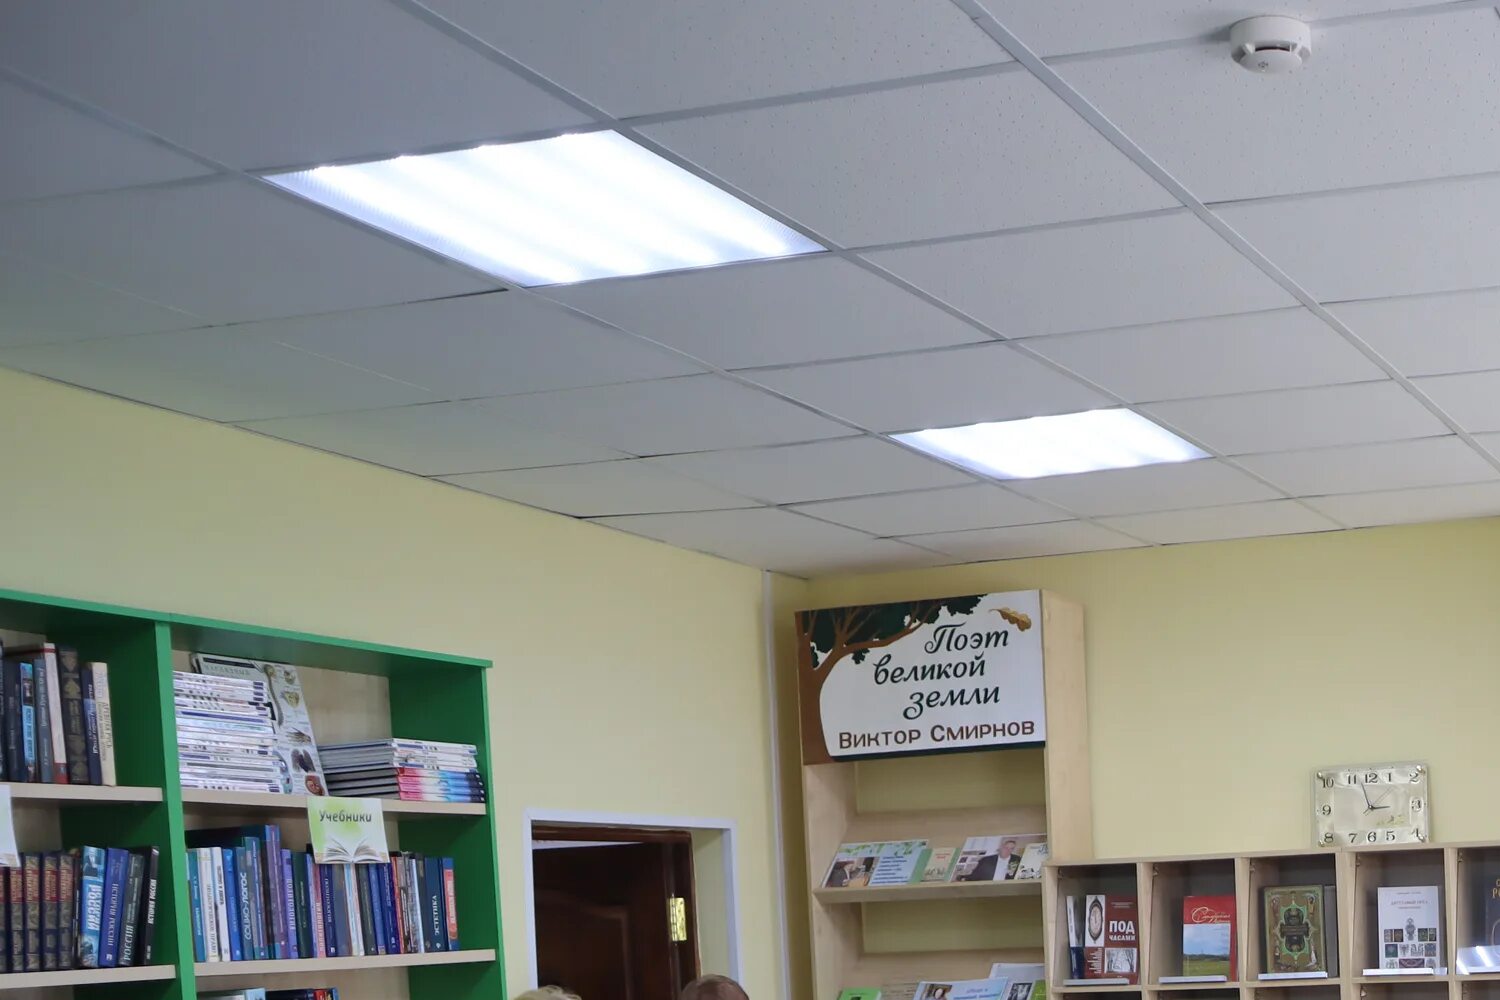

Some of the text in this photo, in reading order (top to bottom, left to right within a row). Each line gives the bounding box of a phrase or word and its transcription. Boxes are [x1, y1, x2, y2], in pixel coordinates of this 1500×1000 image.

[924, 621, 1009, 654] Поэт
[873, 651, 986, 685] великой
[903, 685, 1000, 720] земли
[1322, 778, 1334, 788] 10
[1347, 774, 1357, 785] 11
[1364, 773, 1378, 784] 12
[1409, 772, 1419, 783] 2
[1322, 805, 1331, 816] 9
[1411, 800, 1421, 812] 3
[319, 809, 372, 822] Учебники
[1324, 833, 1334, 843] 8
[1348, 833, 1357, 843] 7
[1367, 832, 1377, 842] 6
[1386, 831, 1396, 841] 5
[107, 883, 119, 946] ИСТОРИЯ РОССИИ
[1109, 920, 1135, 935] ПОД
[124, 925, 134, 961] РОССИЯ
